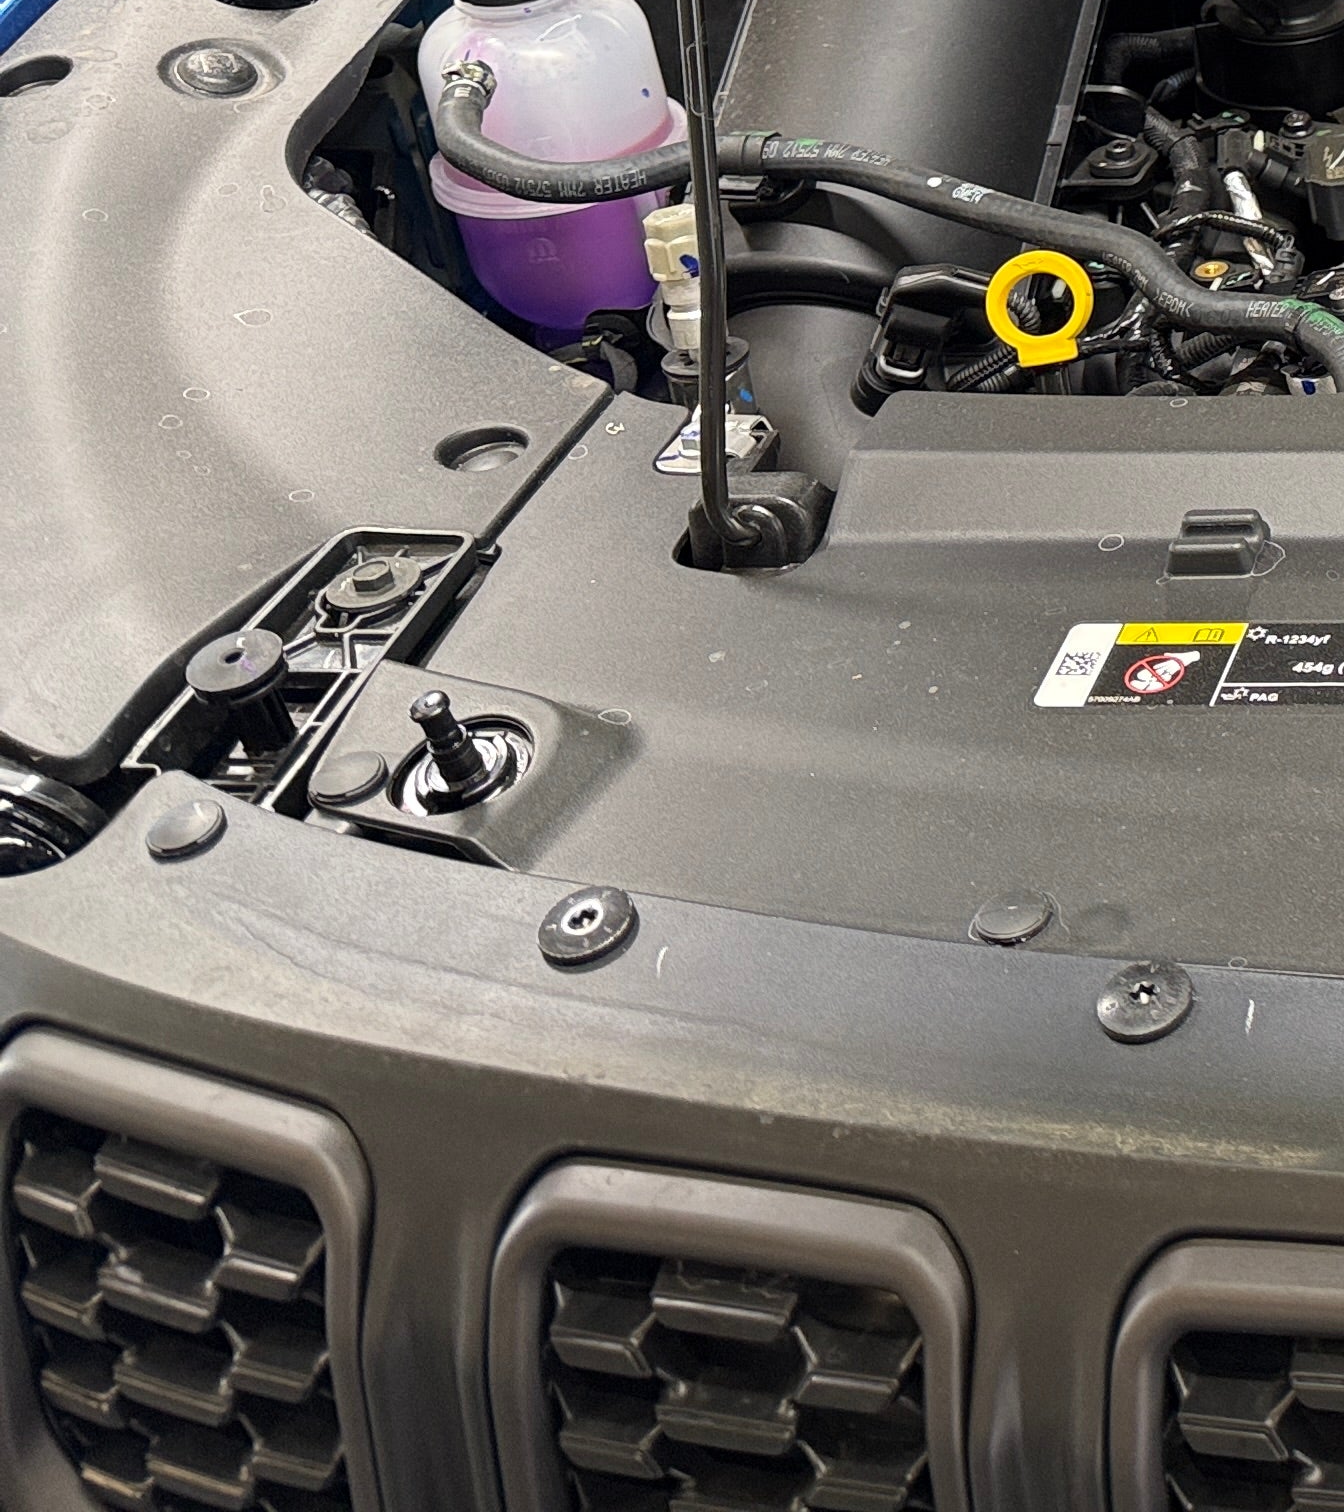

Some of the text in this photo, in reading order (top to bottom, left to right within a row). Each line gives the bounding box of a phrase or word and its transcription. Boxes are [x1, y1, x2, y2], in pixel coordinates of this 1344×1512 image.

[593, 169, 648, 196] HEATER
[1264, 634, 1332, 647] R-1234yf
[1291, 661, 1335, 675] 454g
[1249, 693, 1280, 702] PAG
